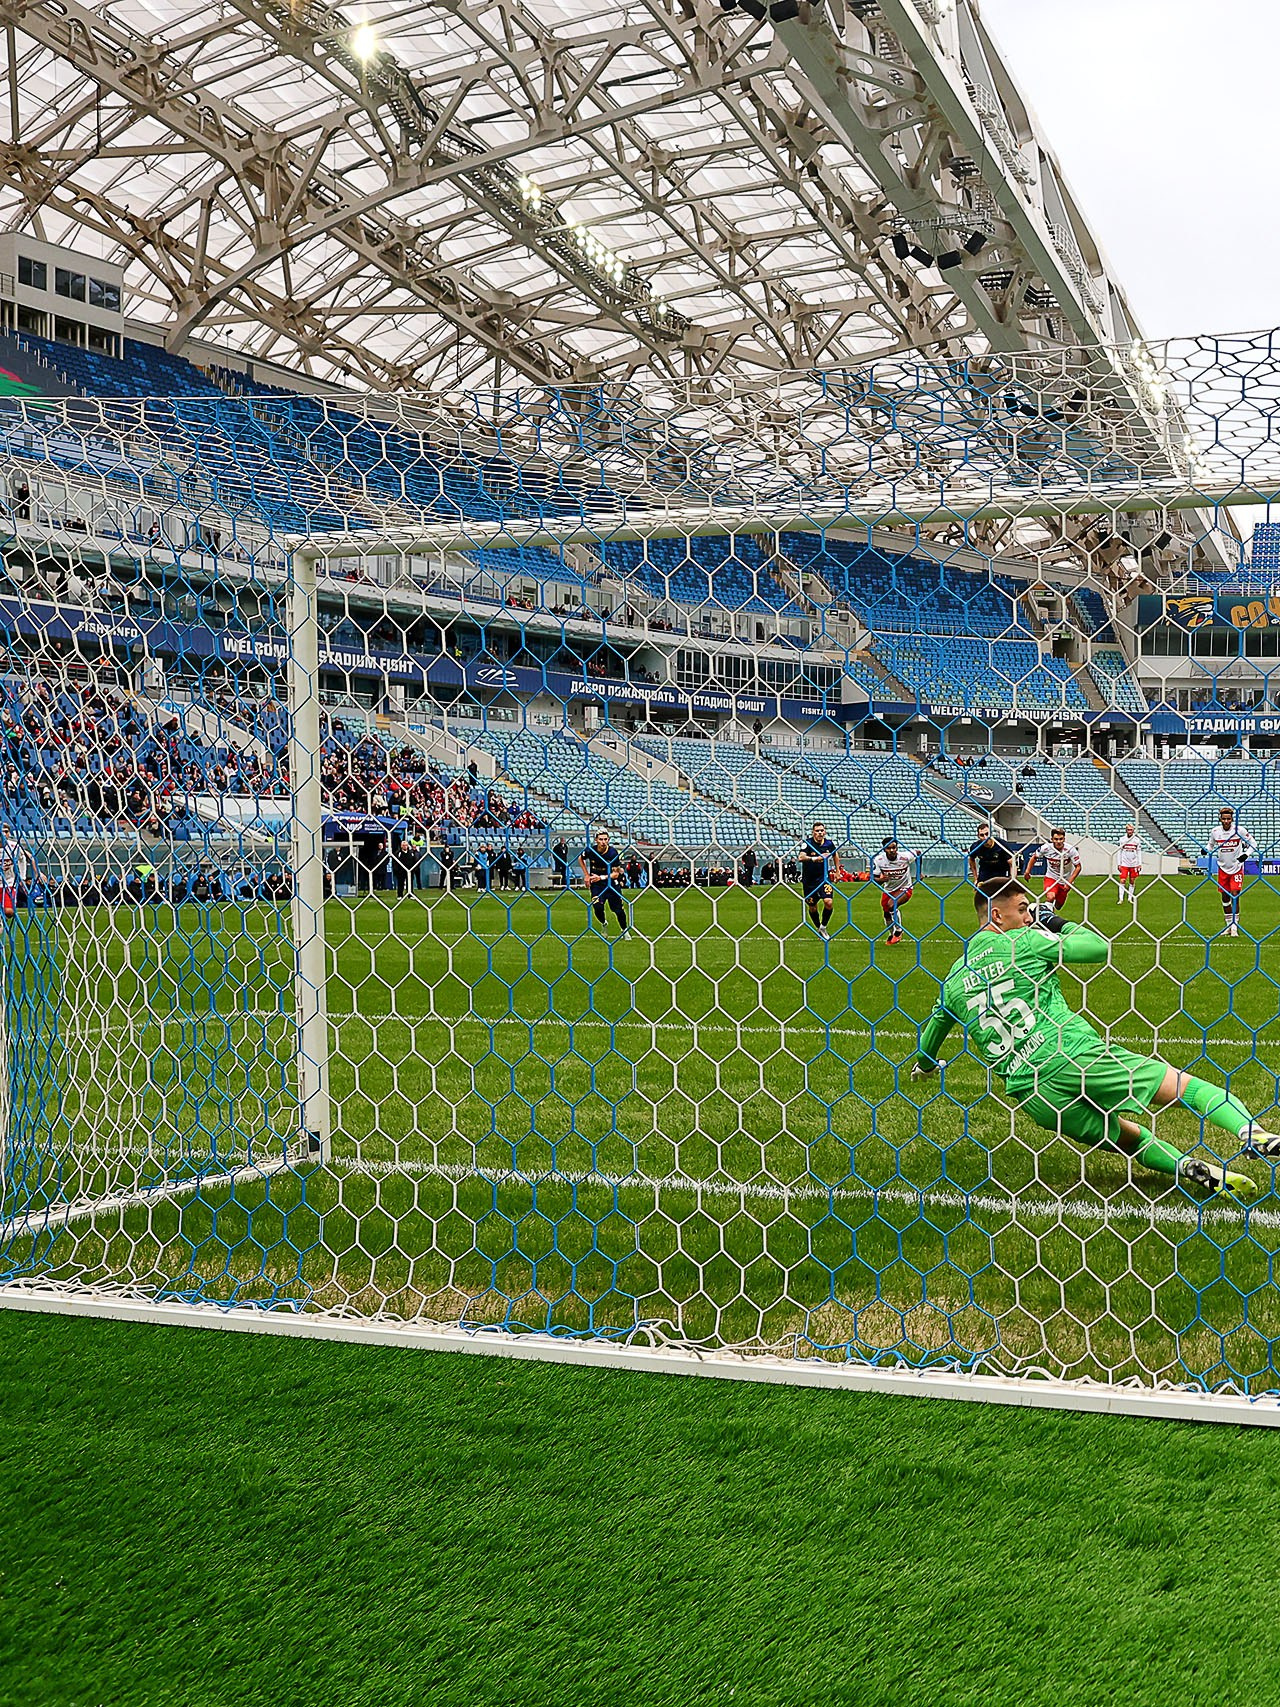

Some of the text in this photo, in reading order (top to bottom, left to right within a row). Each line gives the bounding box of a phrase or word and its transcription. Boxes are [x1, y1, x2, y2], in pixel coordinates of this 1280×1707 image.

[224, 637, 415, 673] WELCOM STADIUM FISHT
[571, 681, 605, 696] ДОБРО
[608, 685, 675, 703] ПОЖАЛОВАТЬ
[693, 696, 735, 709] СТАДИОН
[737, 700, 766, 712] ФИШТ
[801, 707, 837, 717] FISHT.NFO
[930, 705, 1085, 721] WELCOME TO STADIUM FISHT
[1234, 873, 1242, 882] 83
[966, 979, 1036, 1055] 35
